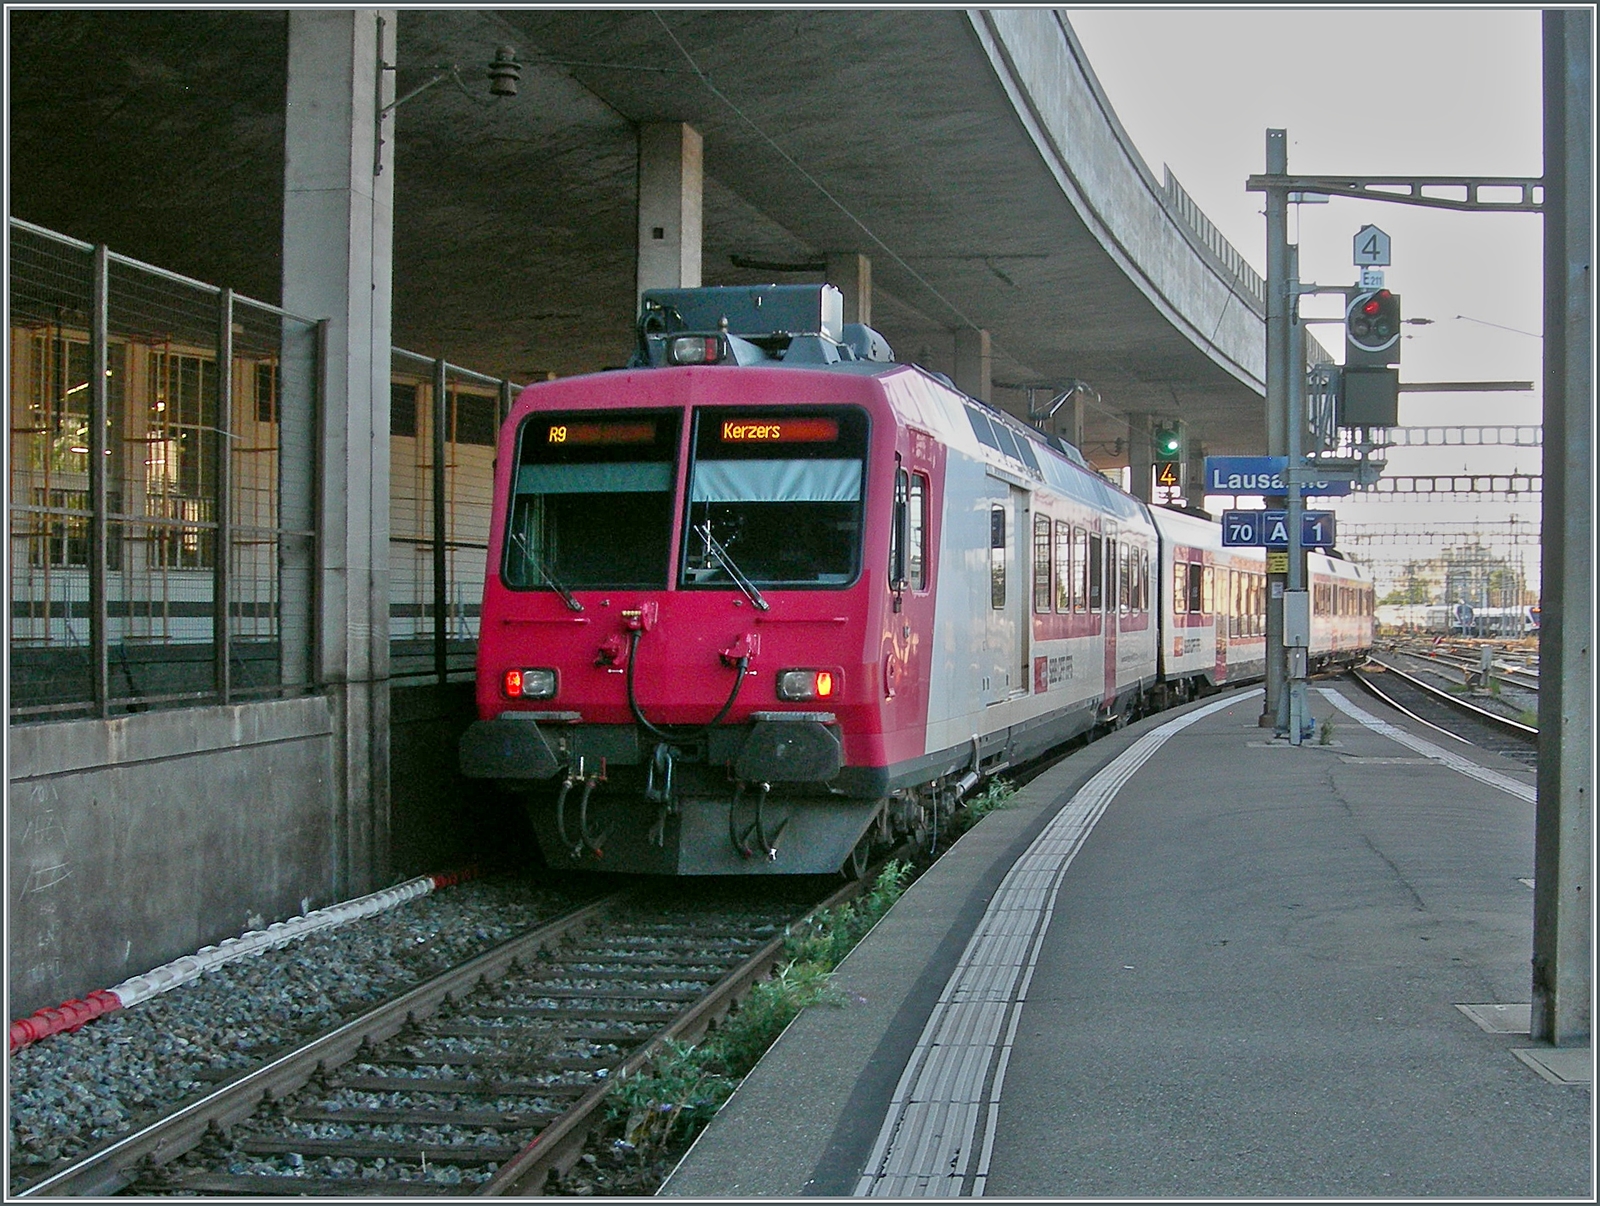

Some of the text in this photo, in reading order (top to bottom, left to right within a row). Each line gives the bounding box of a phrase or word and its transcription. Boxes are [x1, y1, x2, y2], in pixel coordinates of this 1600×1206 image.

[1361, 234, 1381, 261] 4
[549, 426, 567, 443] R9
[724, 422, 781, 439] Kerzers
[1160, 463, 1177, 486] 4
[1230, 524, 1253, 541] 70
[1270, 521, 1289, 541] A
[1312, 522, 1322, 542] 1
